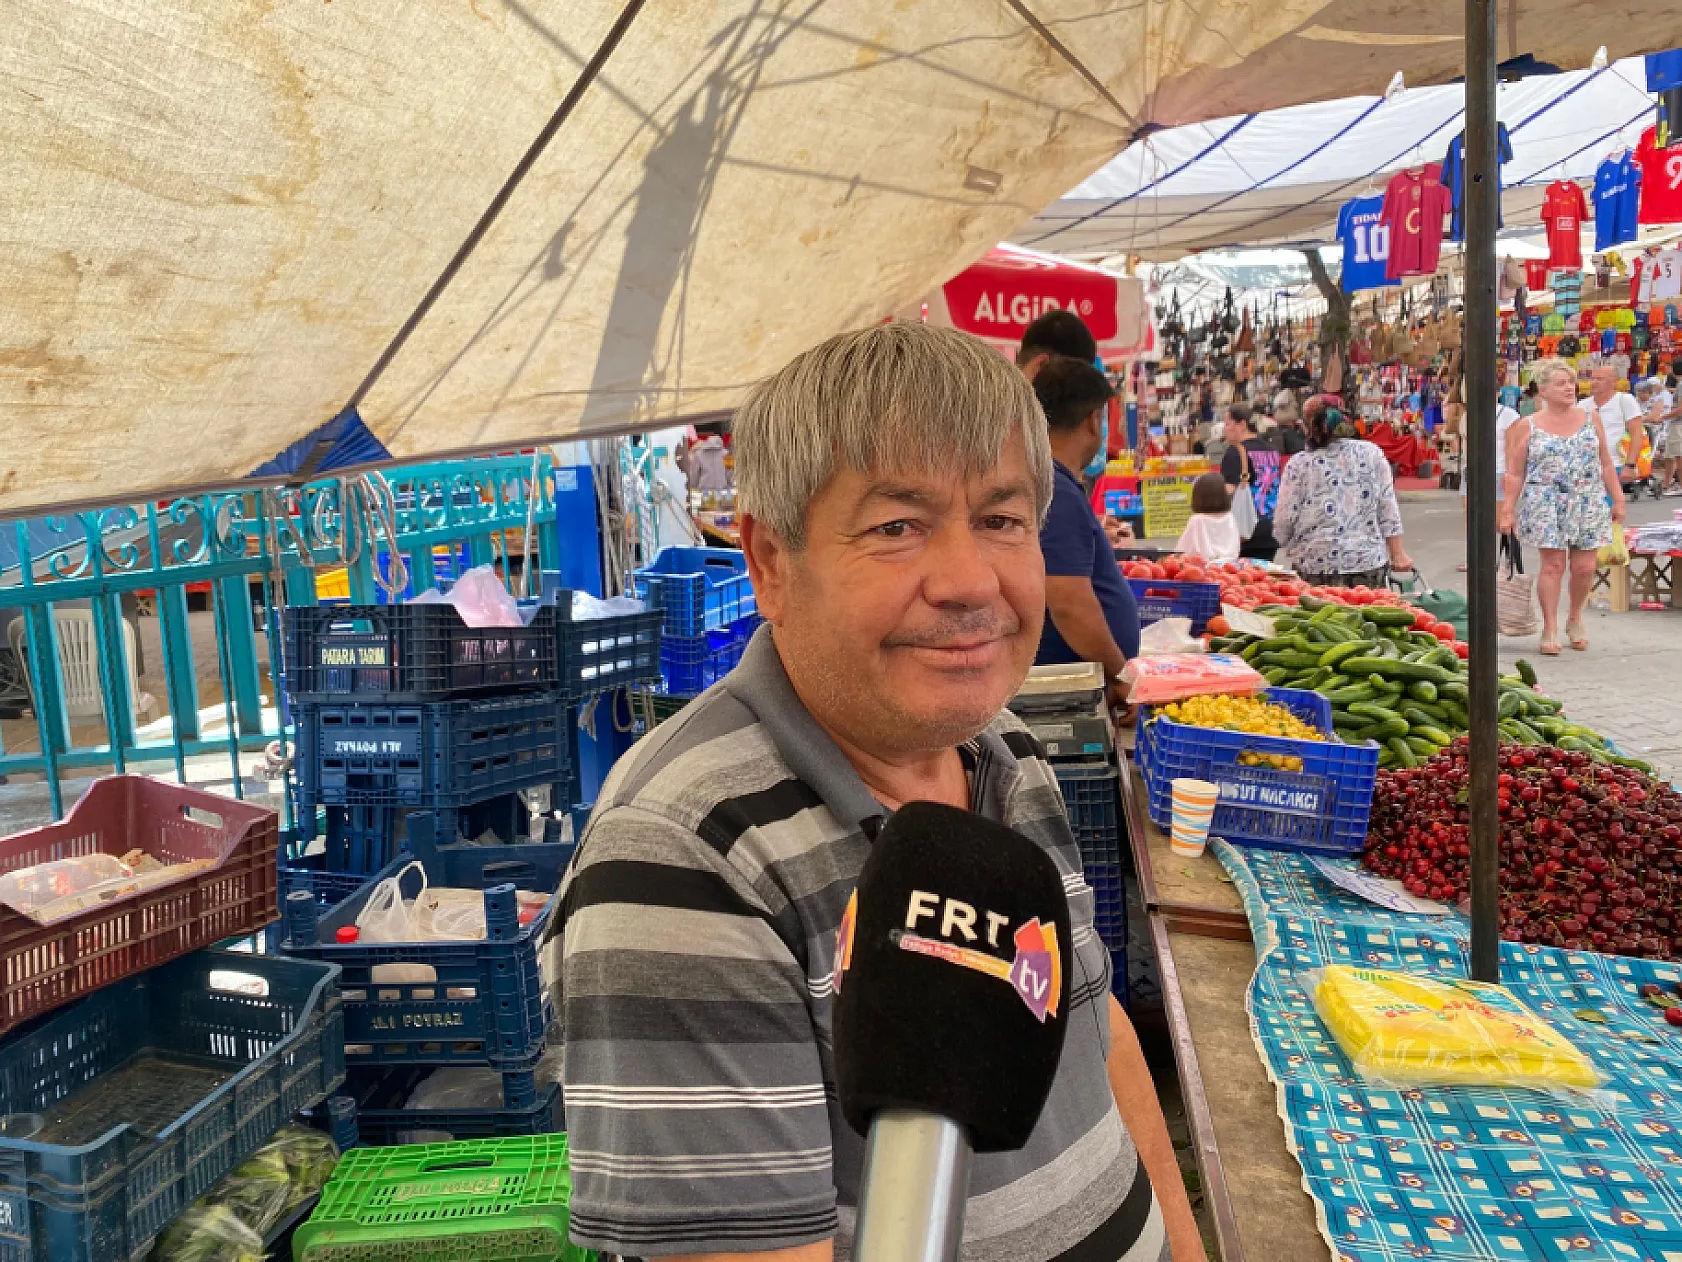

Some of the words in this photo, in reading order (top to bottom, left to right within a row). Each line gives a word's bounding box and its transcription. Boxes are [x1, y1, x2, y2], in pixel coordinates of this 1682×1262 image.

[1353, 225, 1390, 263] 10
[904, 889, 1010, 948] FRT
[1018, 956, 1050, 1000] tv
